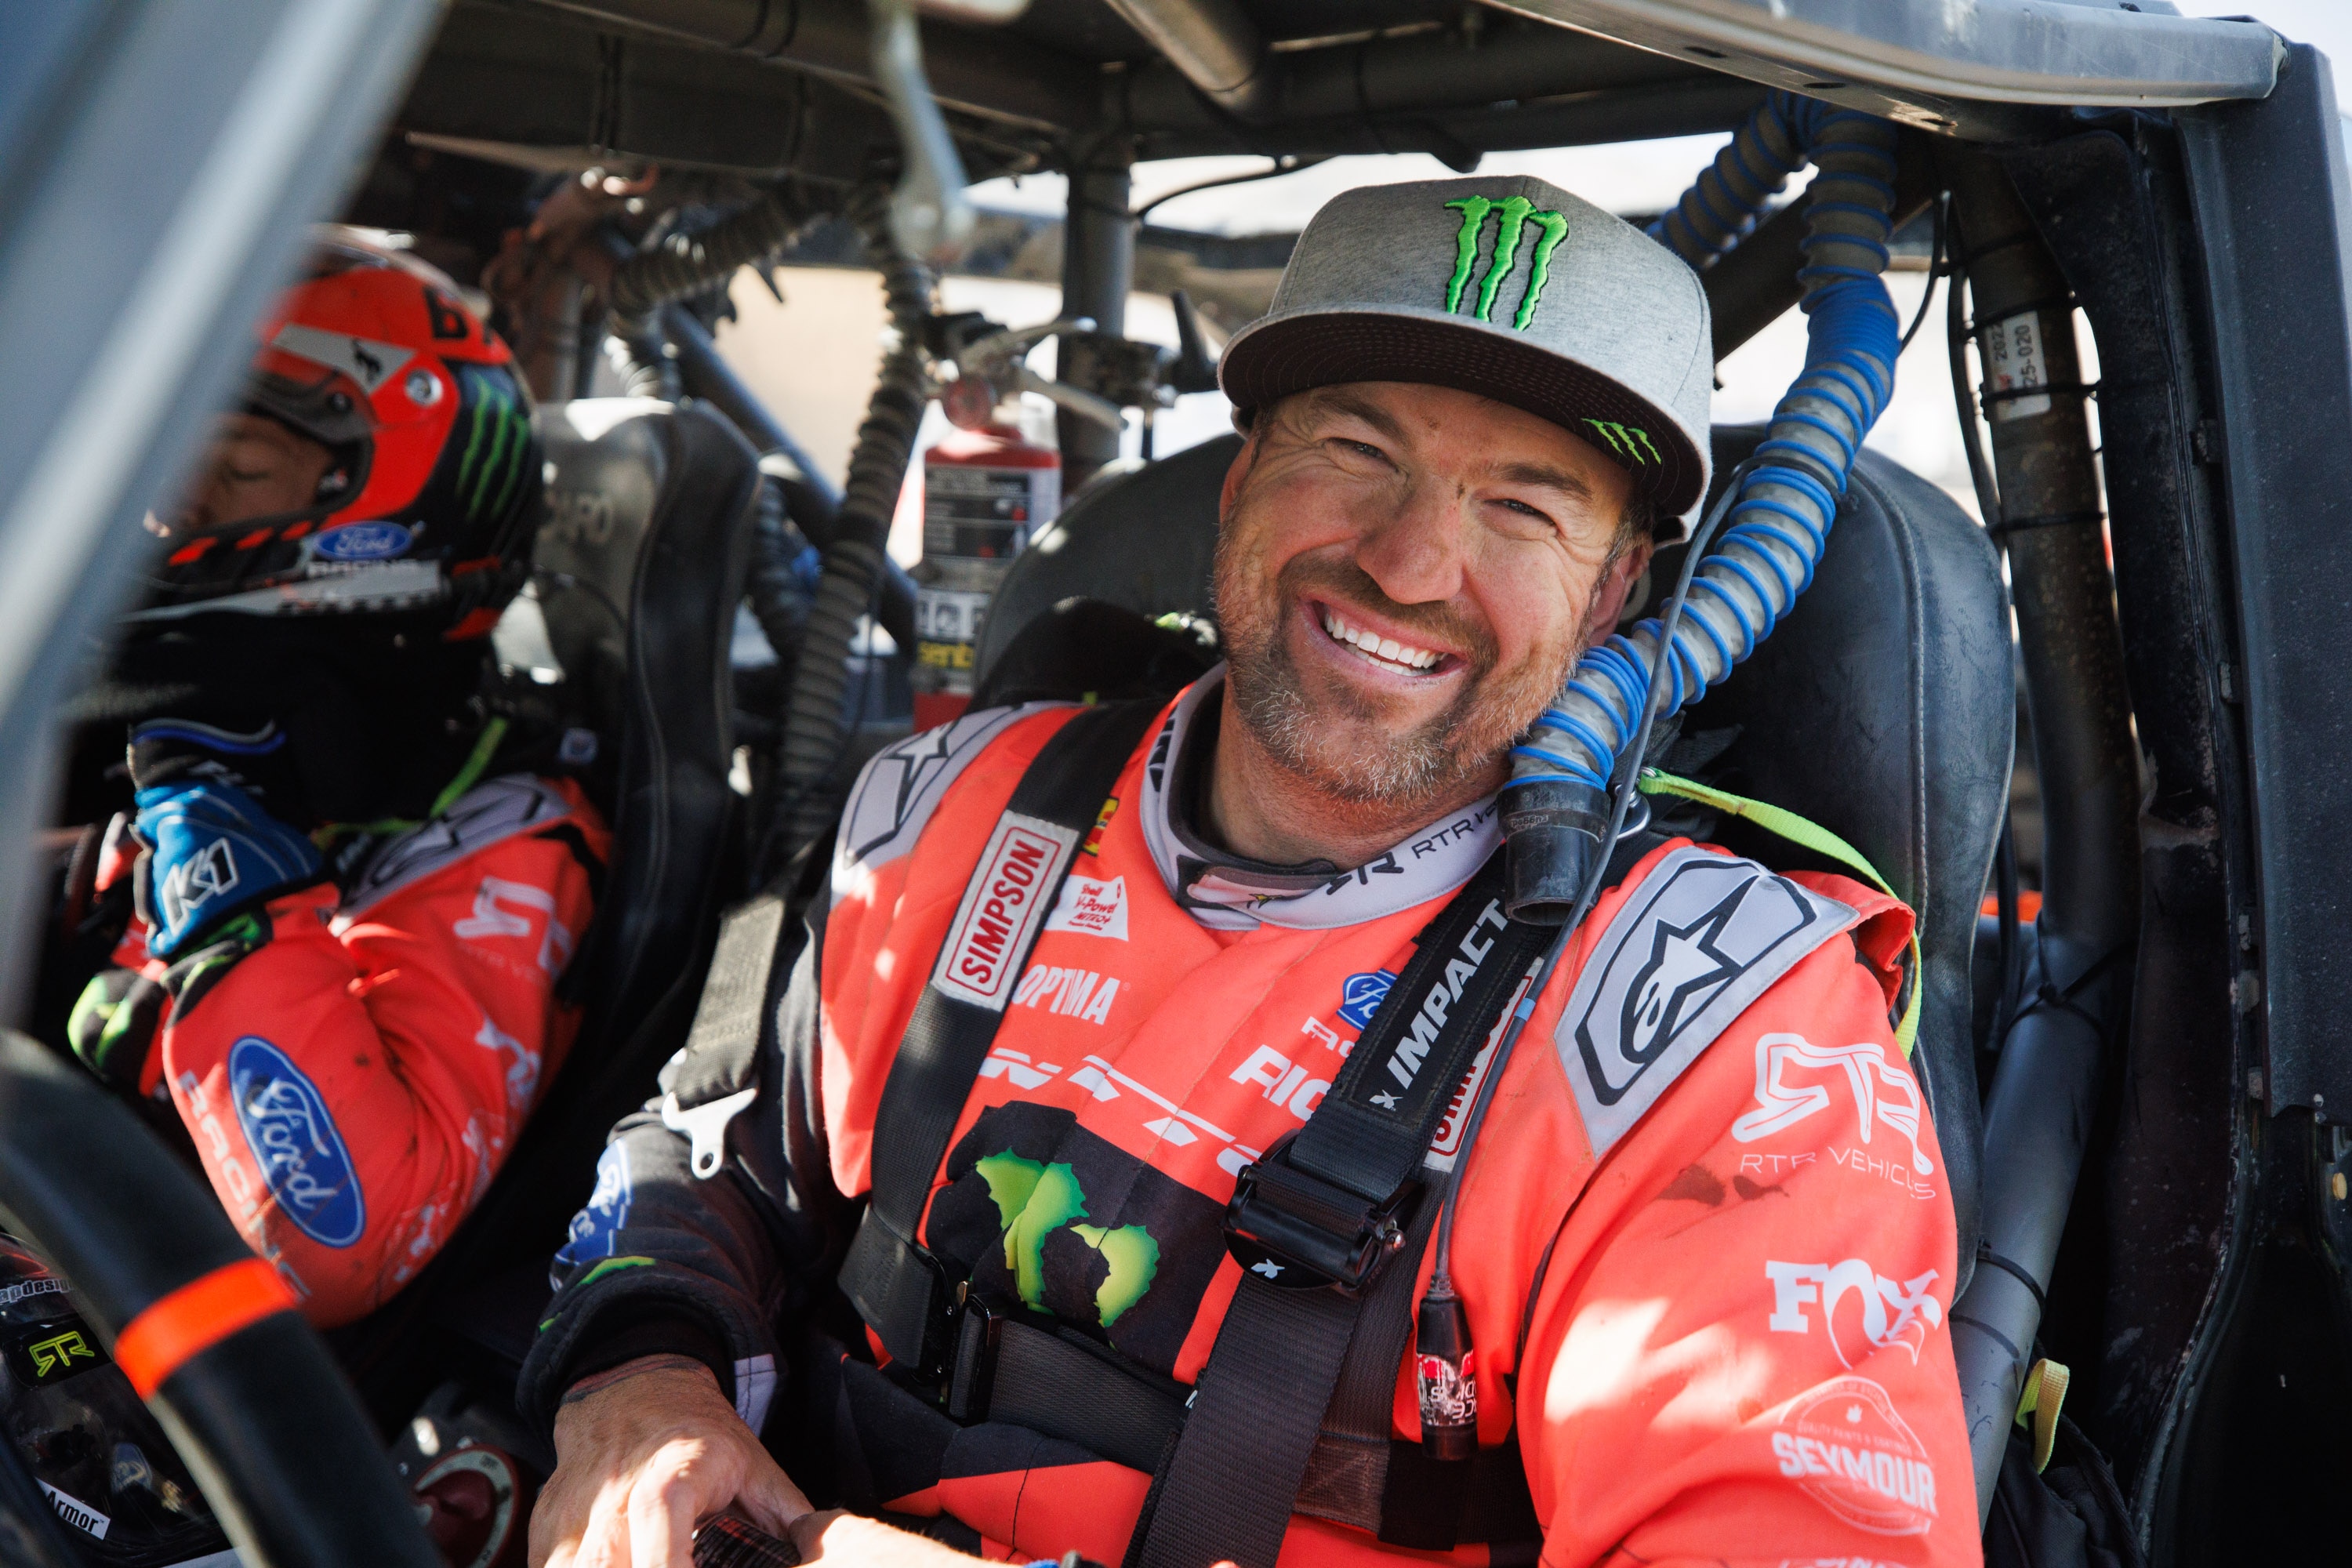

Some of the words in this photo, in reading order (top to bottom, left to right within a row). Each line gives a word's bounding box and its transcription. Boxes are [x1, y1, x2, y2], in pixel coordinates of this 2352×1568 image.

[1411, 818, 1474, 859] RTR
[961, 840, 1045, 984] SIMPSON
[1387, 898, 1508, 1090] IMPACT
[247, 1076, 339, 1212] Ford
[1740, 1152, 1817, 1174] RTR
[29, 1330, 95, 1377] RTR
[1766, 1258, 1942, 1370] FOX
[1771, 1431, 1940, 1519] SEYMOUR
